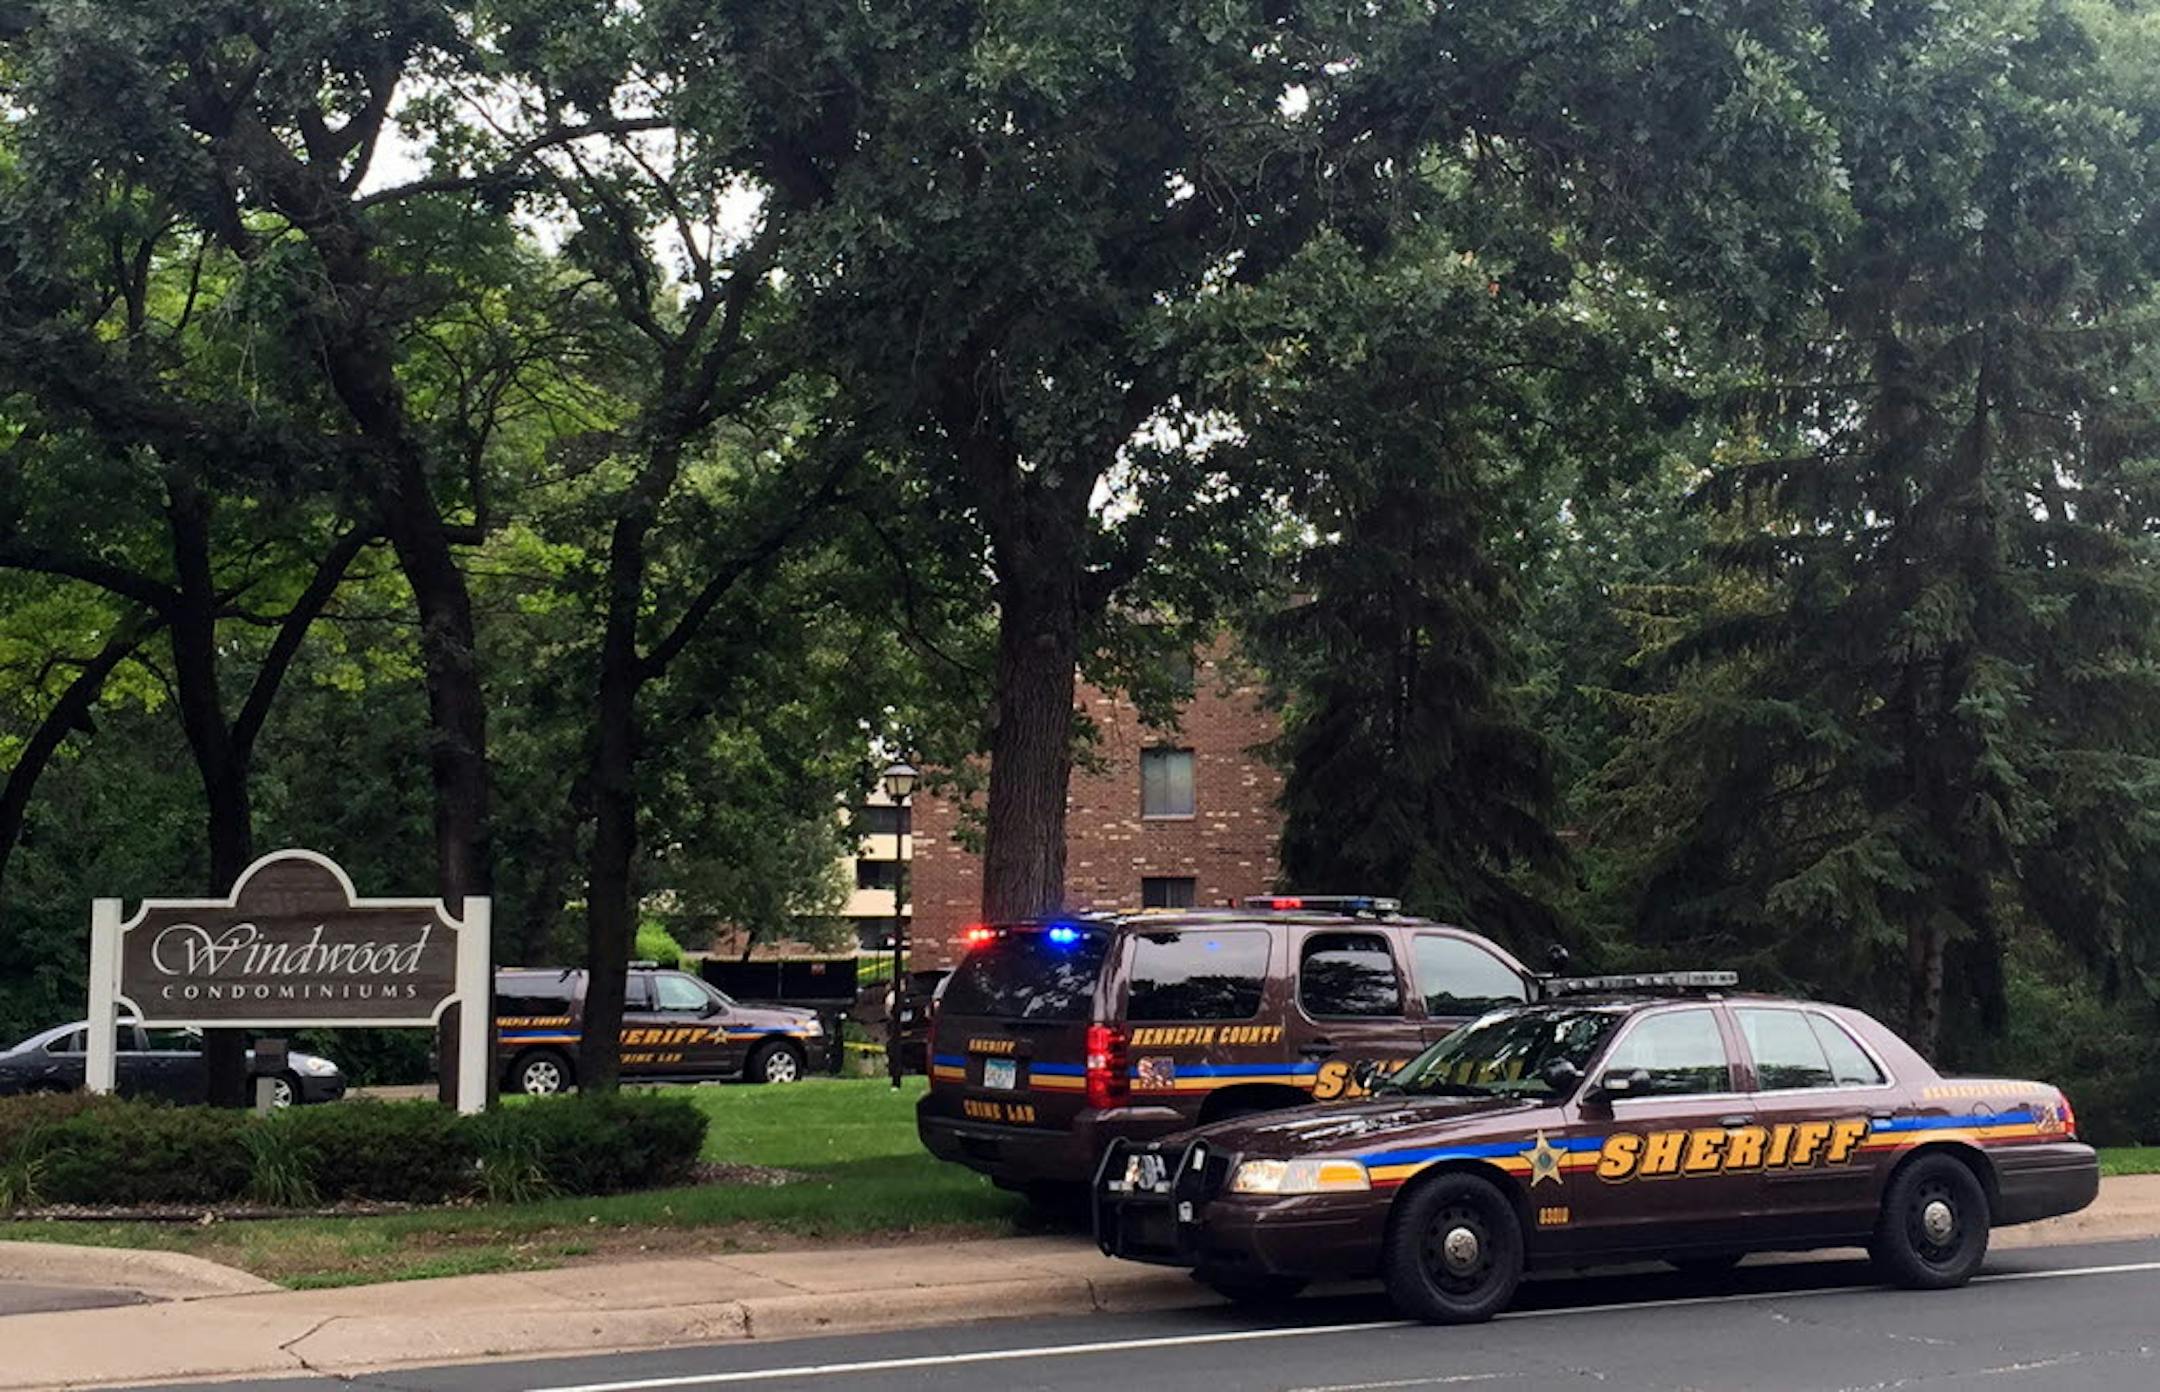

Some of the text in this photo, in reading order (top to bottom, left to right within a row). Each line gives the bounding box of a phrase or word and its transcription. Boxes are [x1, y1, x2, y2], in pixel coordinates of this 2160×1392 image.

[152, 922, 432, 976] Windwood
[161, 984, 417, 999] CONDOMINIUMS
[968, 1039, 1016, 1053] SHERIFF
[1130, 1026, 1282, 1046] HENNEPIN COUNTY
[963, 1100, 1035, 1121] CRIME LAB
[1599, 1119, 1870, 1182] SHERIFF
